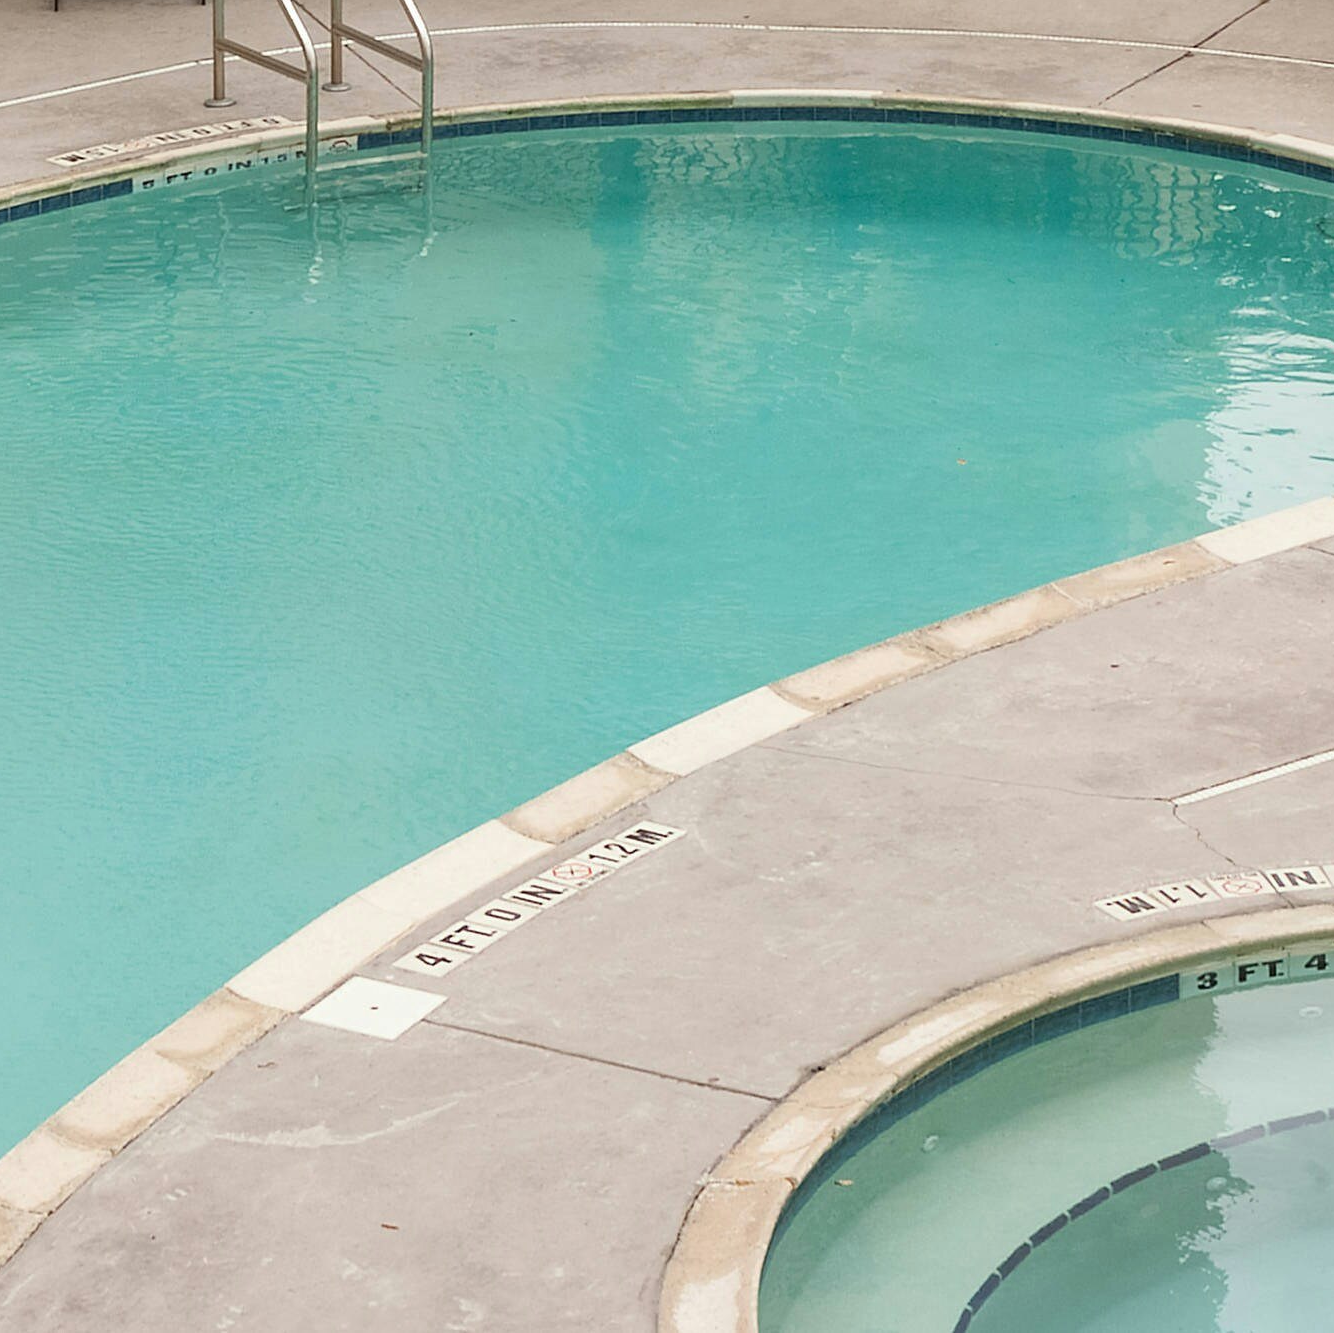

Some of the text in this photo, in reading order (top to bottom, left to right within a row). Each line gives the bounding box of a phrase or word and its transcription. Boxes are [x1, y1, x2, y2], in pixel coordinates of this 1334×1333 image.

[415, 828, 674, 966] 4 FT. 0 IN. 1.2 M.
[1106, 896, 1156, 914] M.
[1159, 884, 1207, 903] 1.1
[1197, 971, 1218, 990] 3
[1238, 959, 1284, 983] FT.
[1304, 953, 1329, 971] 4
